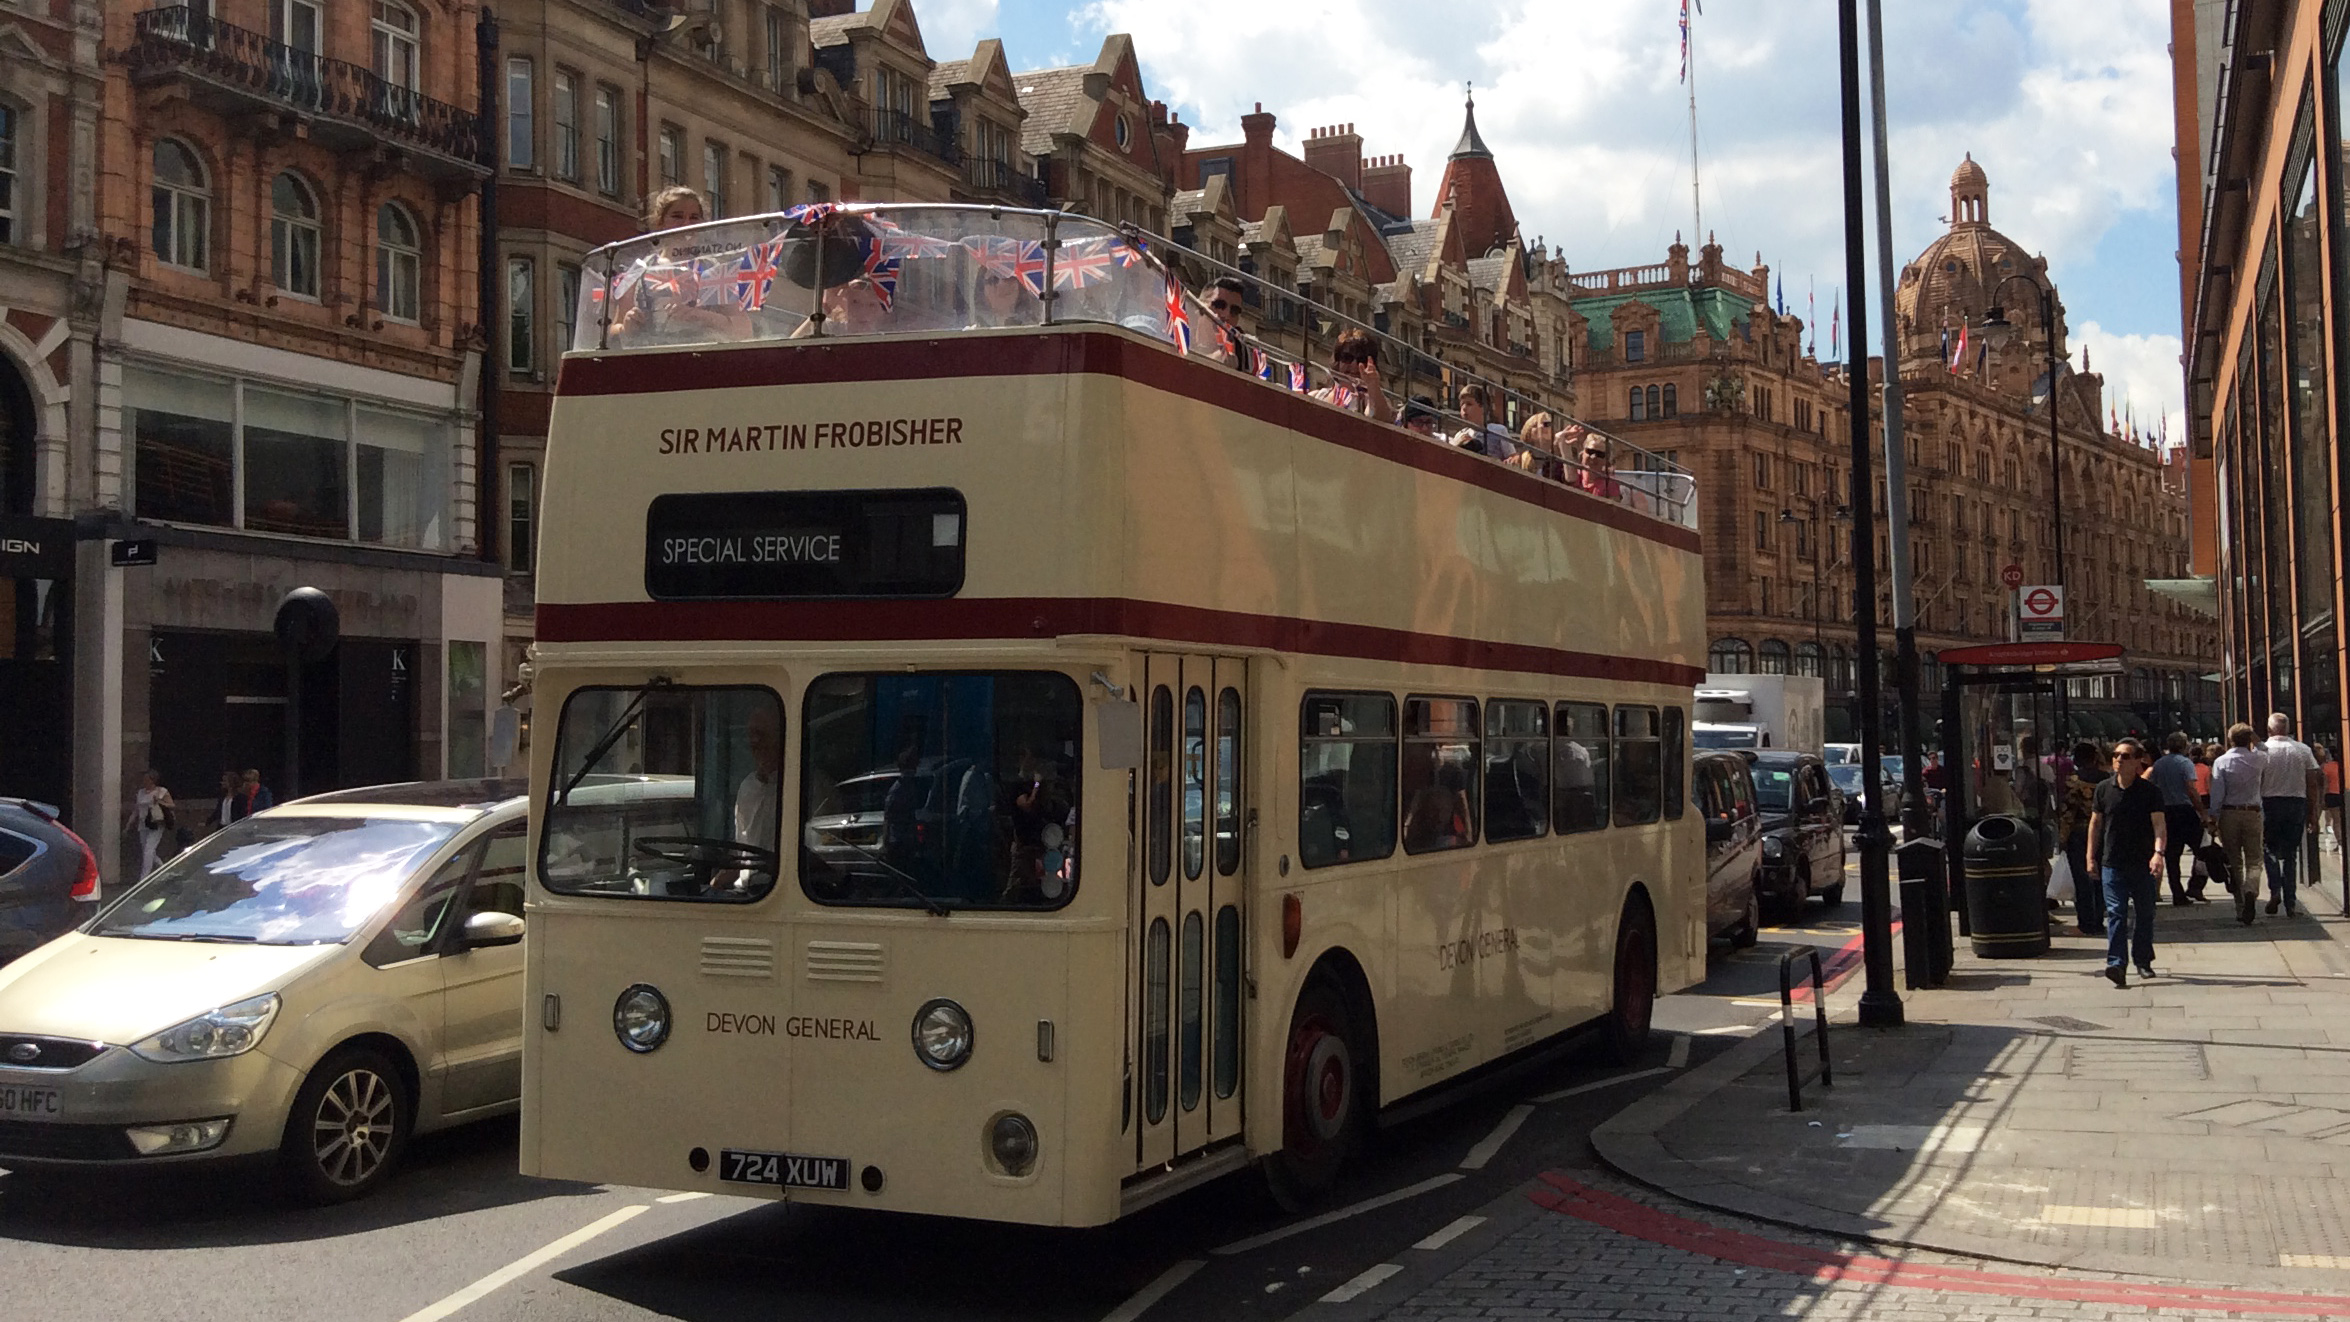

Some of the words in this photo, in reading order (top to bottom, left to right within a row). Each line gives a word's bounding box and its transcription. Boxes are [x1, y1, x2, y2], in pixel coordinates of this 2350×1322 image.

[659, 427, 699, 455] SIR
[706, 423, 807, 453] MARTIN
[814, 417, 963, 449] FROBISHER
[1, 538, 41, 555] IGN
[662, 536, 747, 565] SPECIAL
[752, 535, 841, 563] SERVICE
[2003, 571, 2021, 581] KD
[391, 649, 407, 671] K
[1440, 939, 1474, 971] DEVON
[1478, 928, 1521, 959] GENERAL
[706, 1012, 776, 1036] DEVON
[786, 1016, 881, 1041] GENERAL
[20, 1089, 58, 1113] HFC
[729, 1153, 780, 1183] 724
[786, 1157, 839, 1187] XUW
